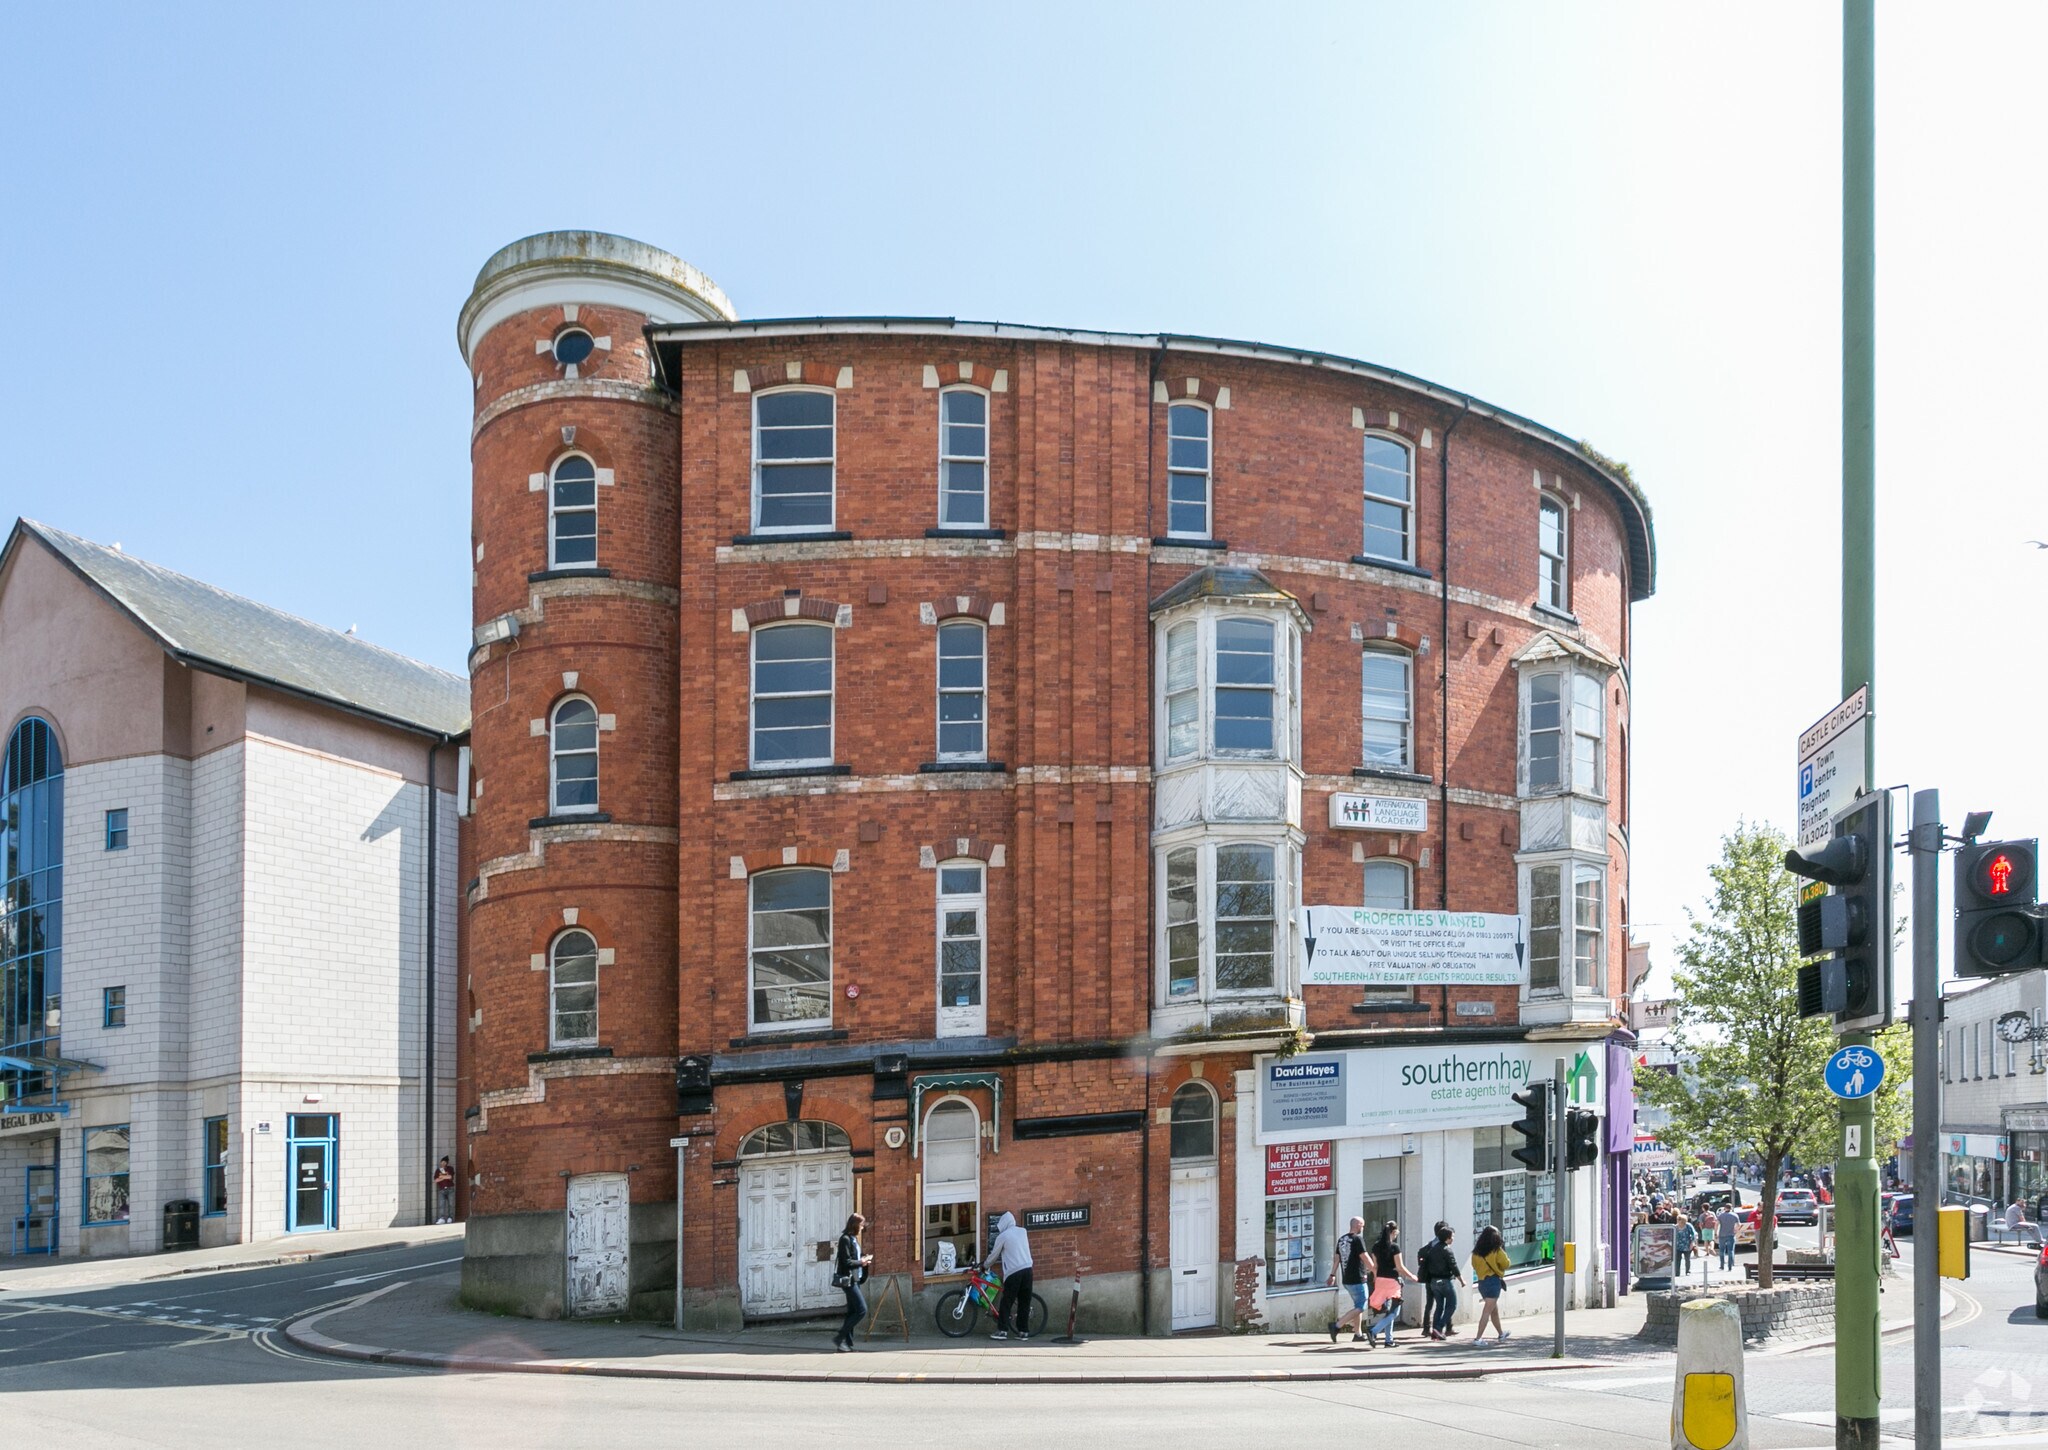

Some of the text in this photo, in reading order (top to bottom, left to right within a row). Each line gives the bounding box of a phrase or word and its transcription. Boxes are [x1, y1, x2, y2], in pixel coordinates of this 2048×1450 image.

[1800, 696, 1862, 754] CASTLE CIRCUS
[1816, 751, 1834, 770] Town
[1814, 766, 1836, 788] centre
[1375, 800, 1419, 810] INTERNATIONAL
[1801, 789, 1830, 815] Paignton
[1375, 808, 1419, 818] LANGUAGE
[1375, 816, 1420, 826] ACADEMY
[1802, 808, 1828, 831] Brixham
[1801, 881, 1828, 904] (A380)
[1354, 910, 1486, 928] PROPERTIES WANTED
[1362, 928, 1388, 936] SERIOUS
[1377, 950, 1391, 958] OUR
[1447, 951, 1477, 959] TECHNIQUE
[1313, 972, 1381, 981] SOUTHERNHAY
[1383, 972, 1416, 981] ESTATE
[1418, 972, 1449, 981] AGENTS
[1451, 973, 1482, 982] PRODUCE
[1276, 1065, 1334, 1077] David Hayes
[1401, 1052, 1531, 1086] southernhay
[1431, 1082, 1510, 1100] estate agents ltd
[1282, 1106, 1328, 1116] 01803 290005
[1, 1112, 56, 1130] REGAL HOUSE
[1848, 1142, 1856, 1152] A
[1271, 1158, 1329, 1169] NEXT AUCTION
[1295, 1169, 1318, 1177] DETAILS
[1272, 1178, 1297, 1186] ENQUIRE
[1032, 1214, 1049, 1222] TOM'S
[1051, 1212, 1070, 1221] COFFEE
[1072, 1211, 1083, 1219] BAR
